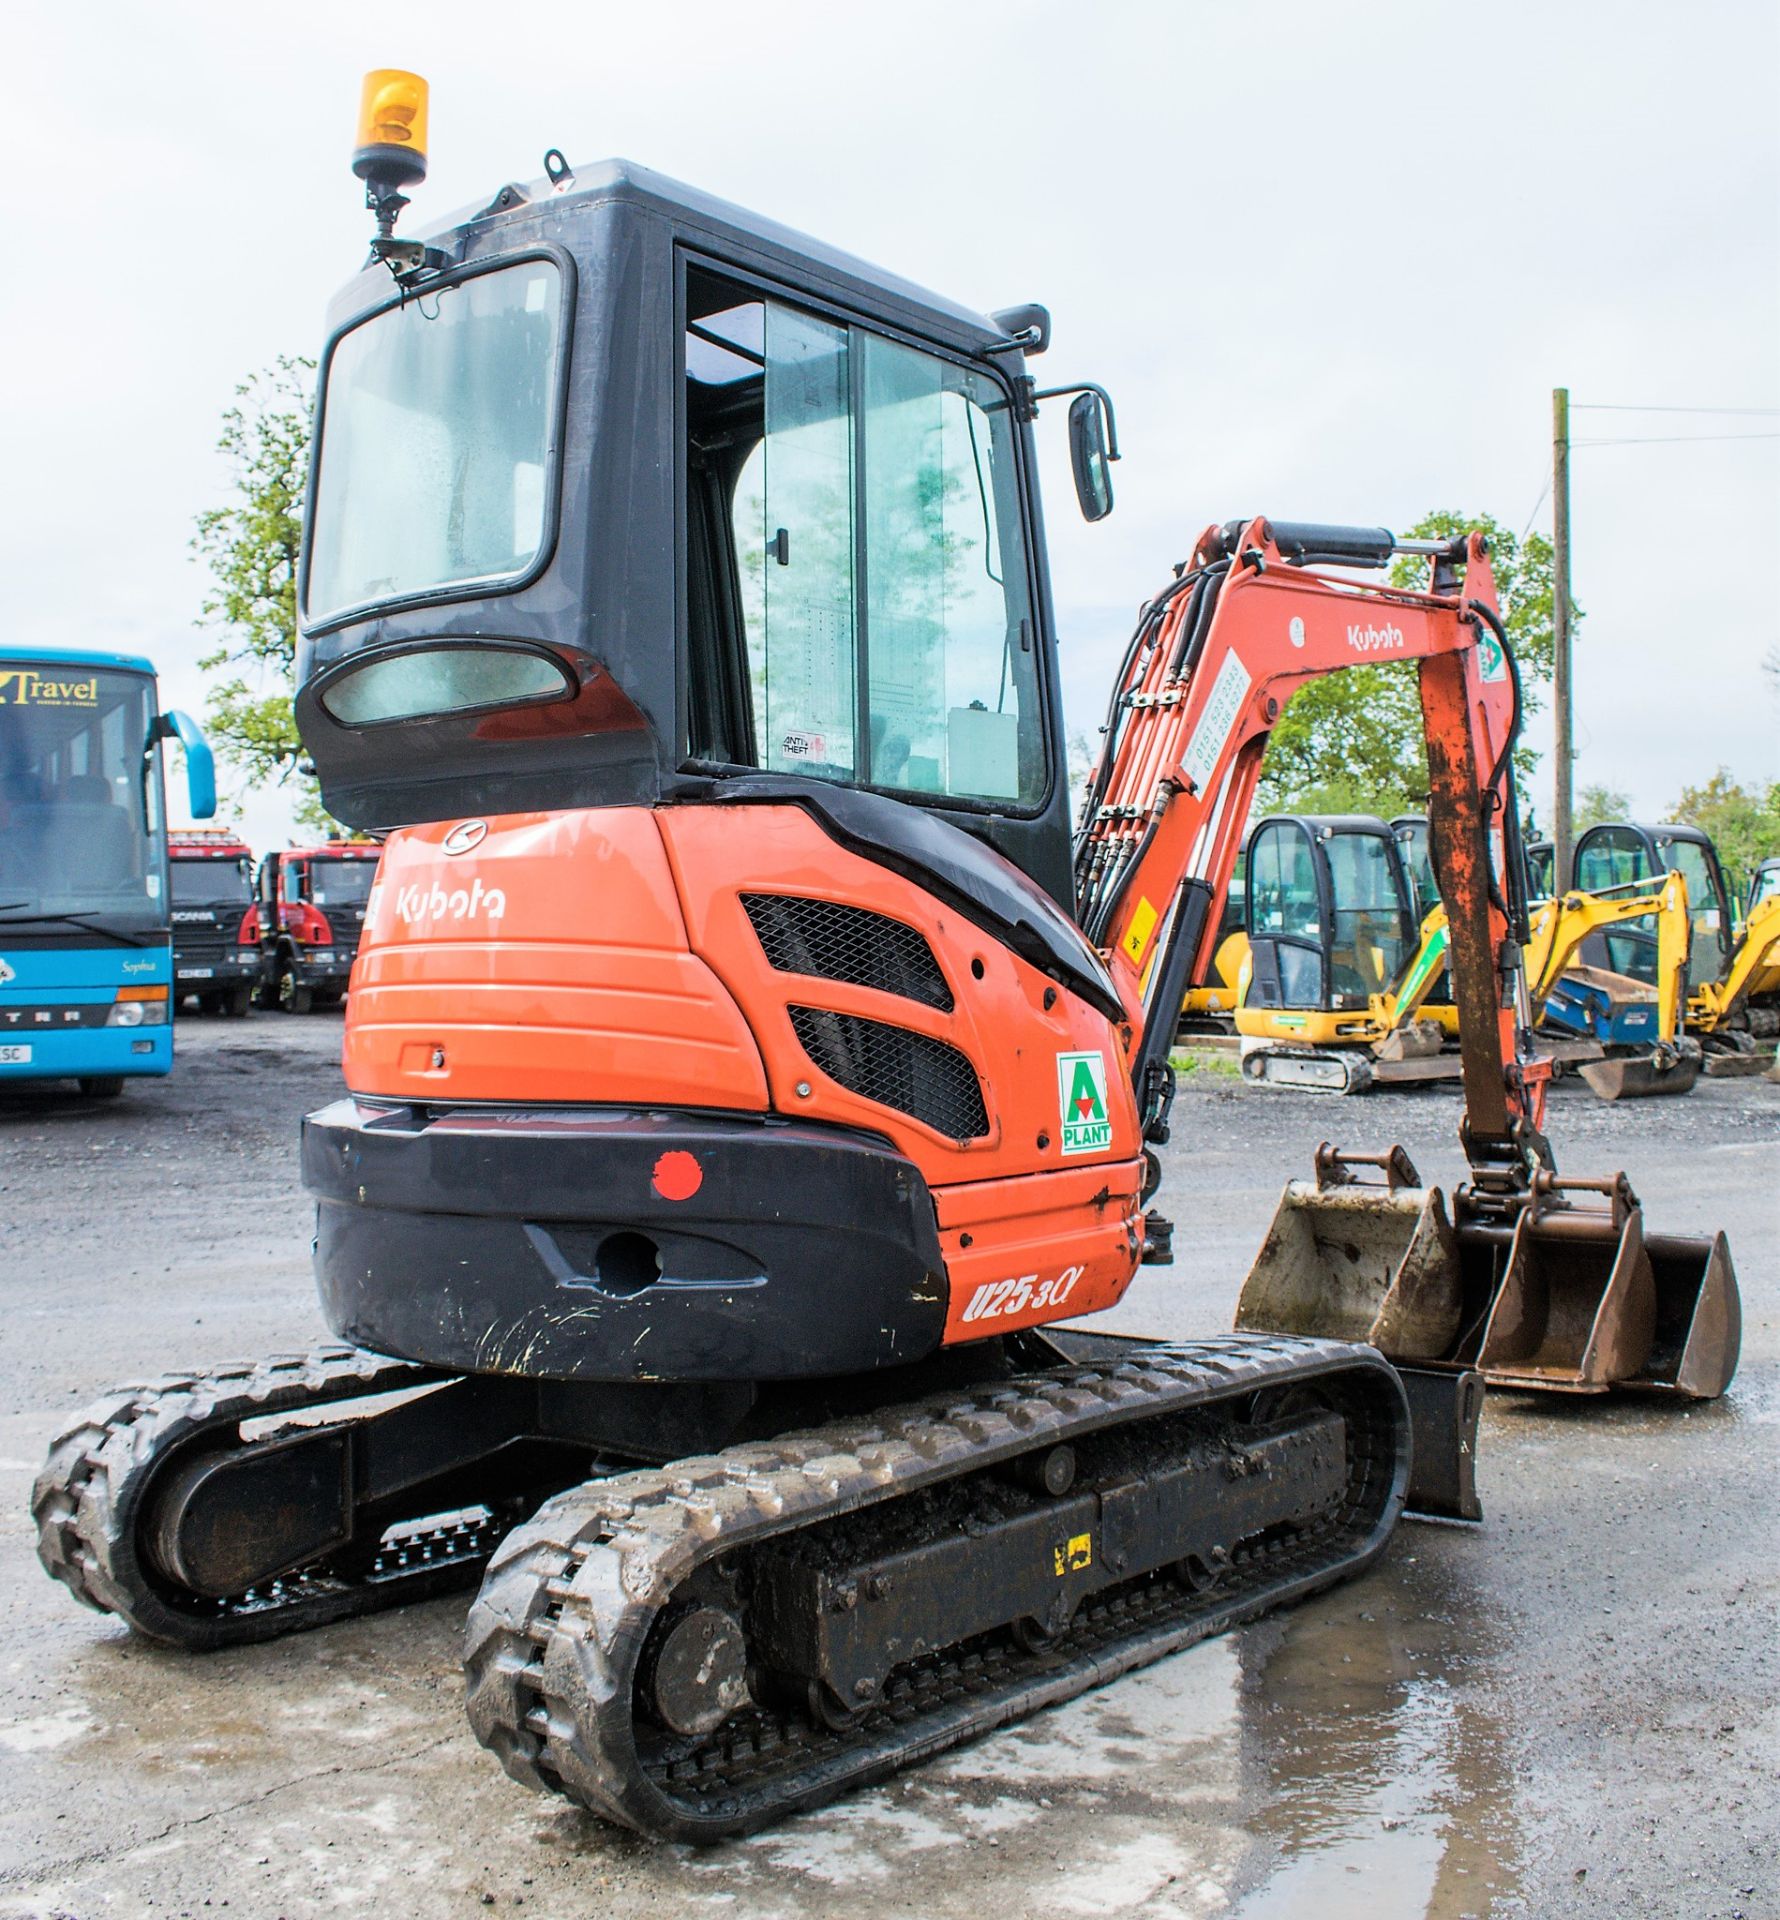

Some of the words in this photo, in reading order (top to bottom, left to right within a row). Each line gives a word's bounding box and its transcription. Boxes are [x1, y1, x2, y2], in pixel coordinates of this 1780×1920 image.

[1347, 622, 1404, 651] Kubota
[11, 671, 97, 704] Travel
[782, 744, 809, 755] THEFT
[1195, 724, 1213, 760] 0151
[1203, 736, 1221, 773] 0151
[395, 878, 506, 924] Kubota
[1066, 1061, 1106, 1123] A
[1063, 1125, 1110, 1146] PLANT
